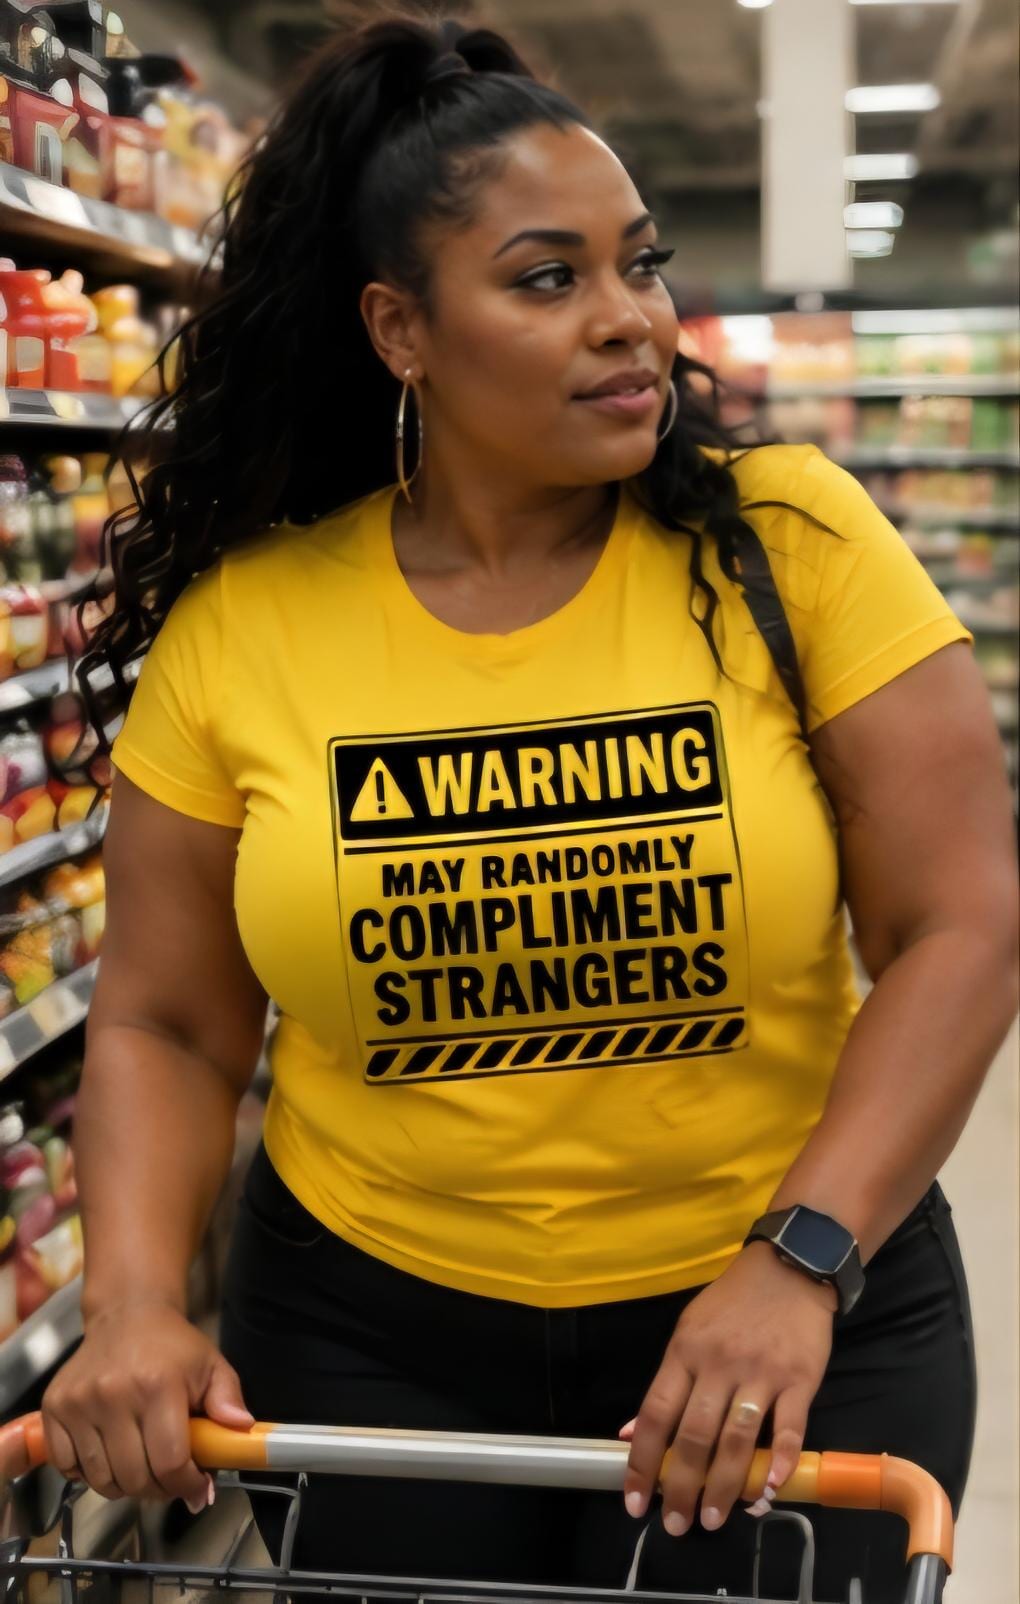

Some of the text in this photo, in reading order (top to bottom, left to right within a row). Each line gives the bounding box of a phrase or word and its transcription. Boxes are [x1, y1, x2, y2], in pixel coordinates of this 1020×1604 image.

[417, 727, 712, 817] WARNING
[382, 834, 695, 897] MAY RANDOMLY
[349, 873, 732, 963] COMPLIMENT
[374, 942, 728, 1026] STRANGERS
